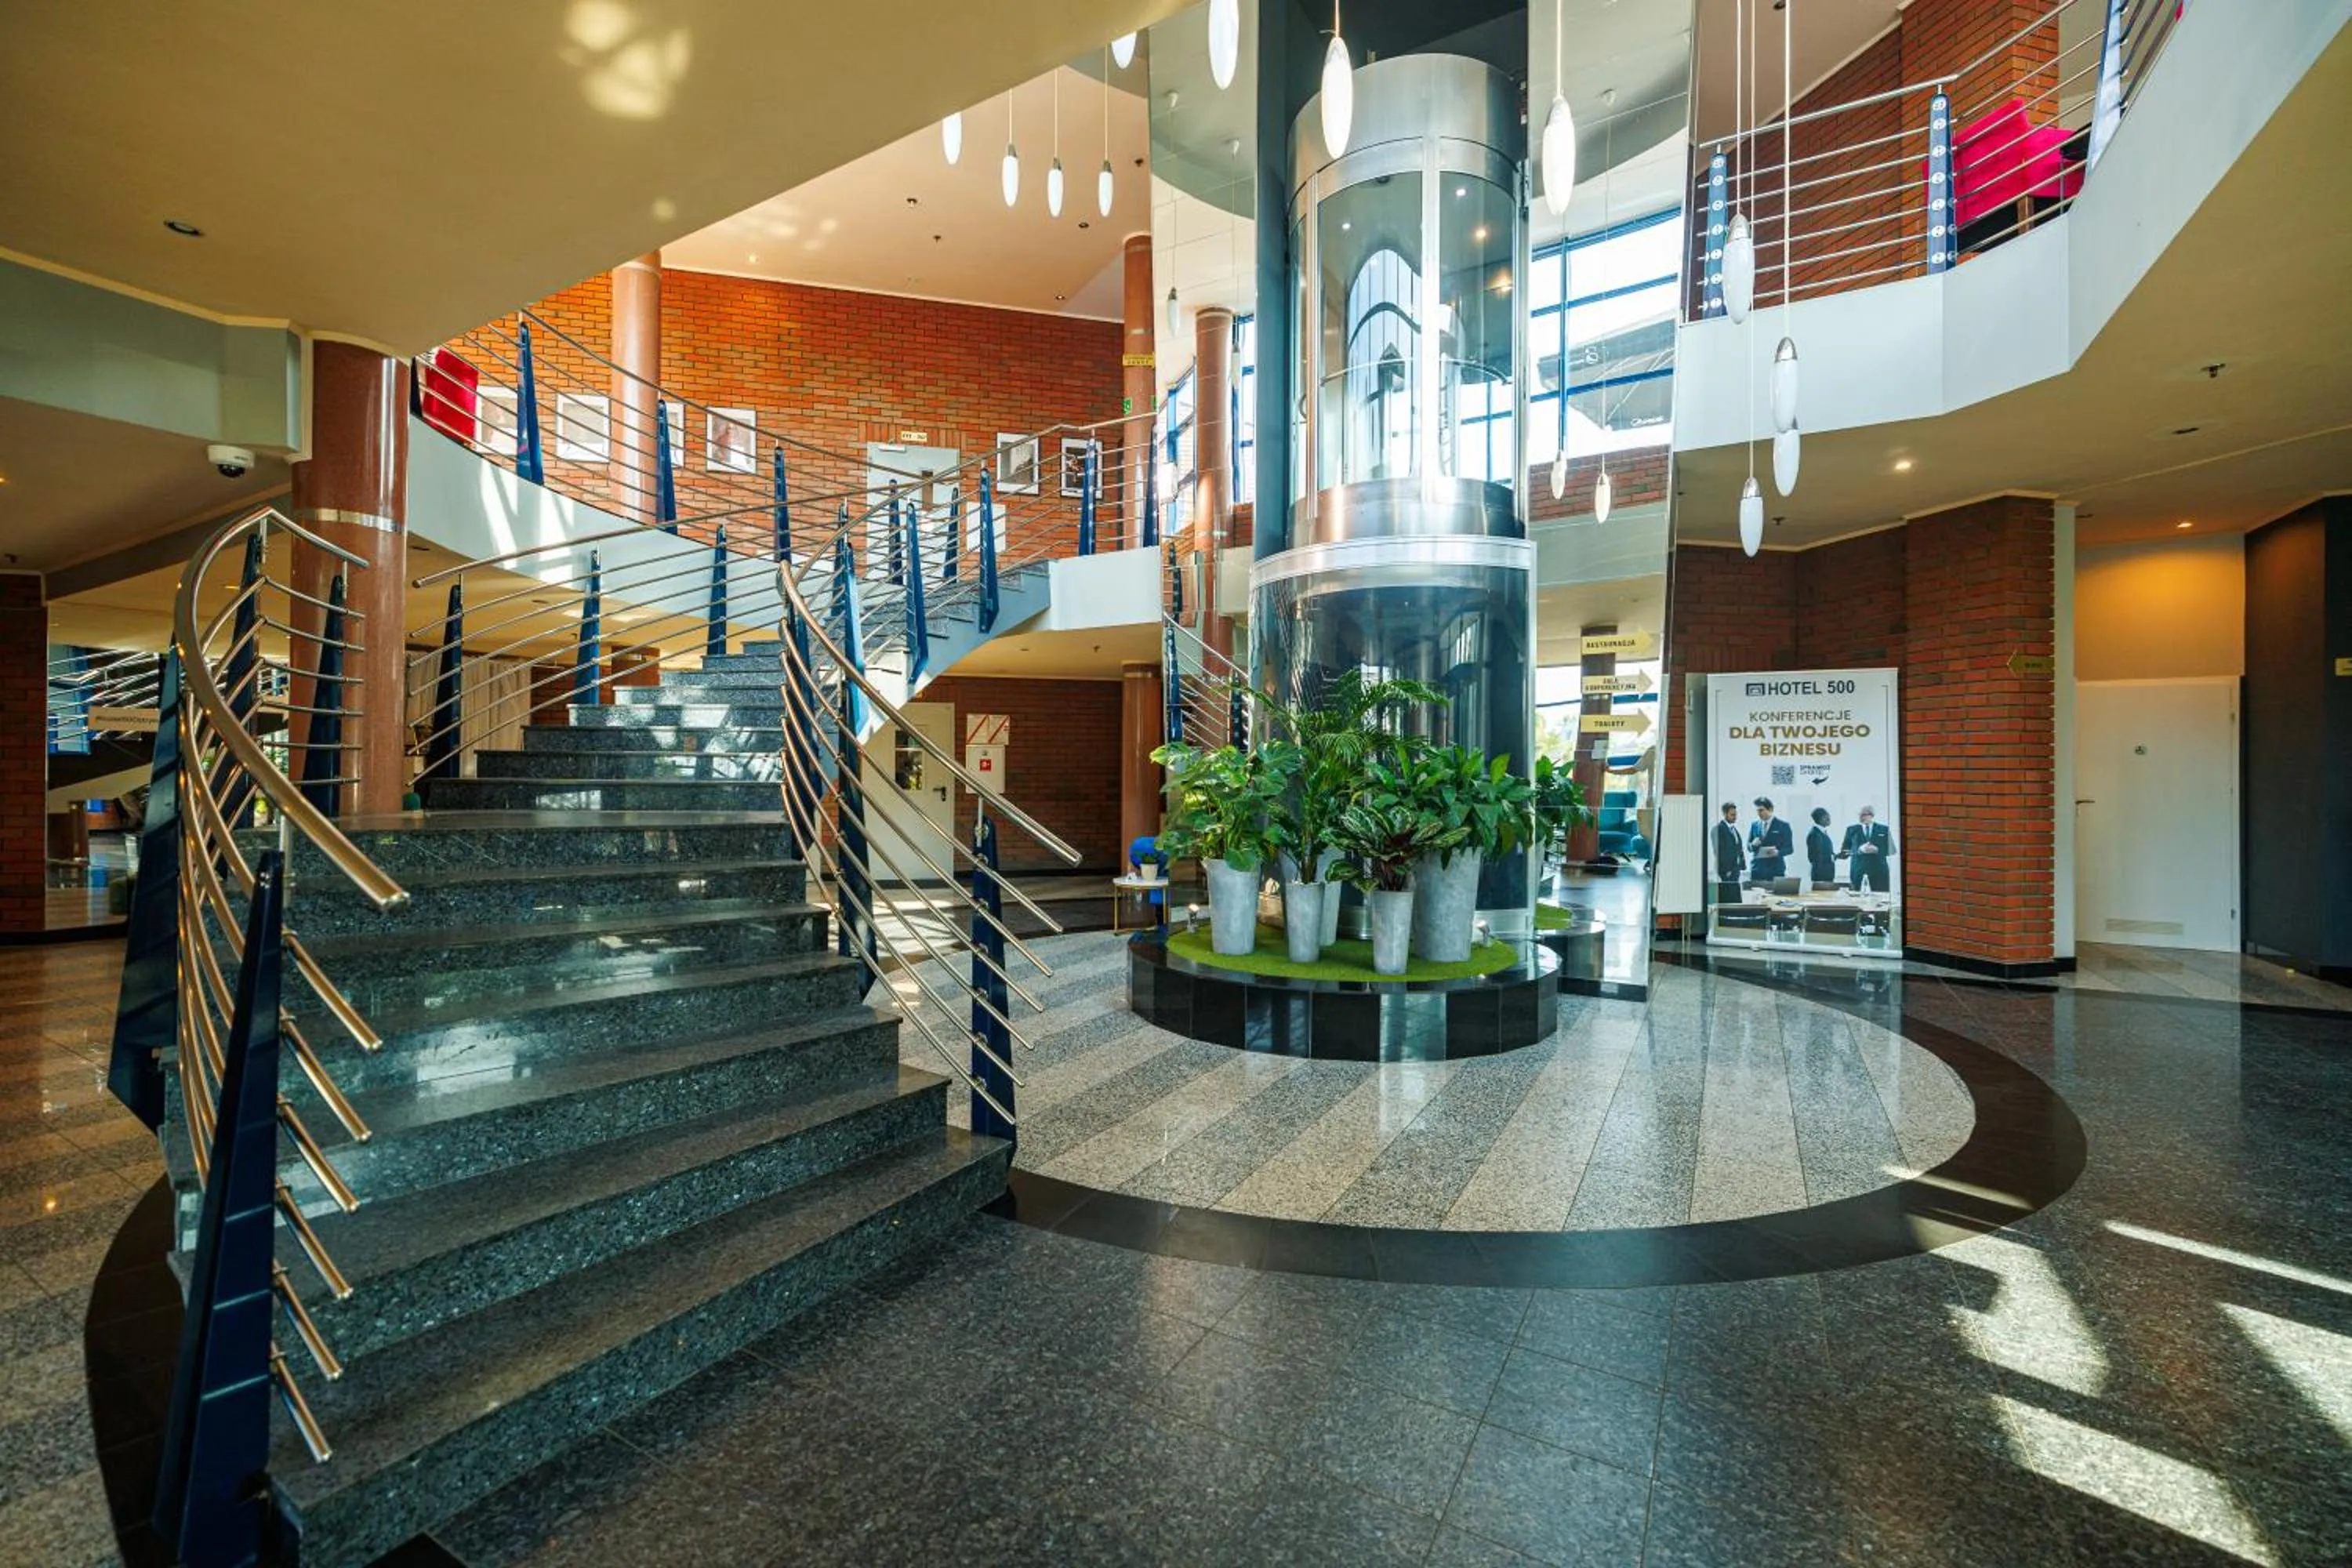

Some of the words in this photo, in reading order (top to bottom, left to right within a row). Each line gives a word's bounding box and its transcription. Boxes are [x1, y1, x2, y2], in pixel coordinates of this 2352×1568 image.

[1768, 681, 1821, 695] HOTEL
[1828, 680, 1855, 694] 500
[1749, 710, 1851, 722] KONFERENCJE
[1730, 727, 1766, 739] DLA
[1769, 724, 1871, 739] TWOJEGO
[1760, 743, 1841, 756] BIZNESU
